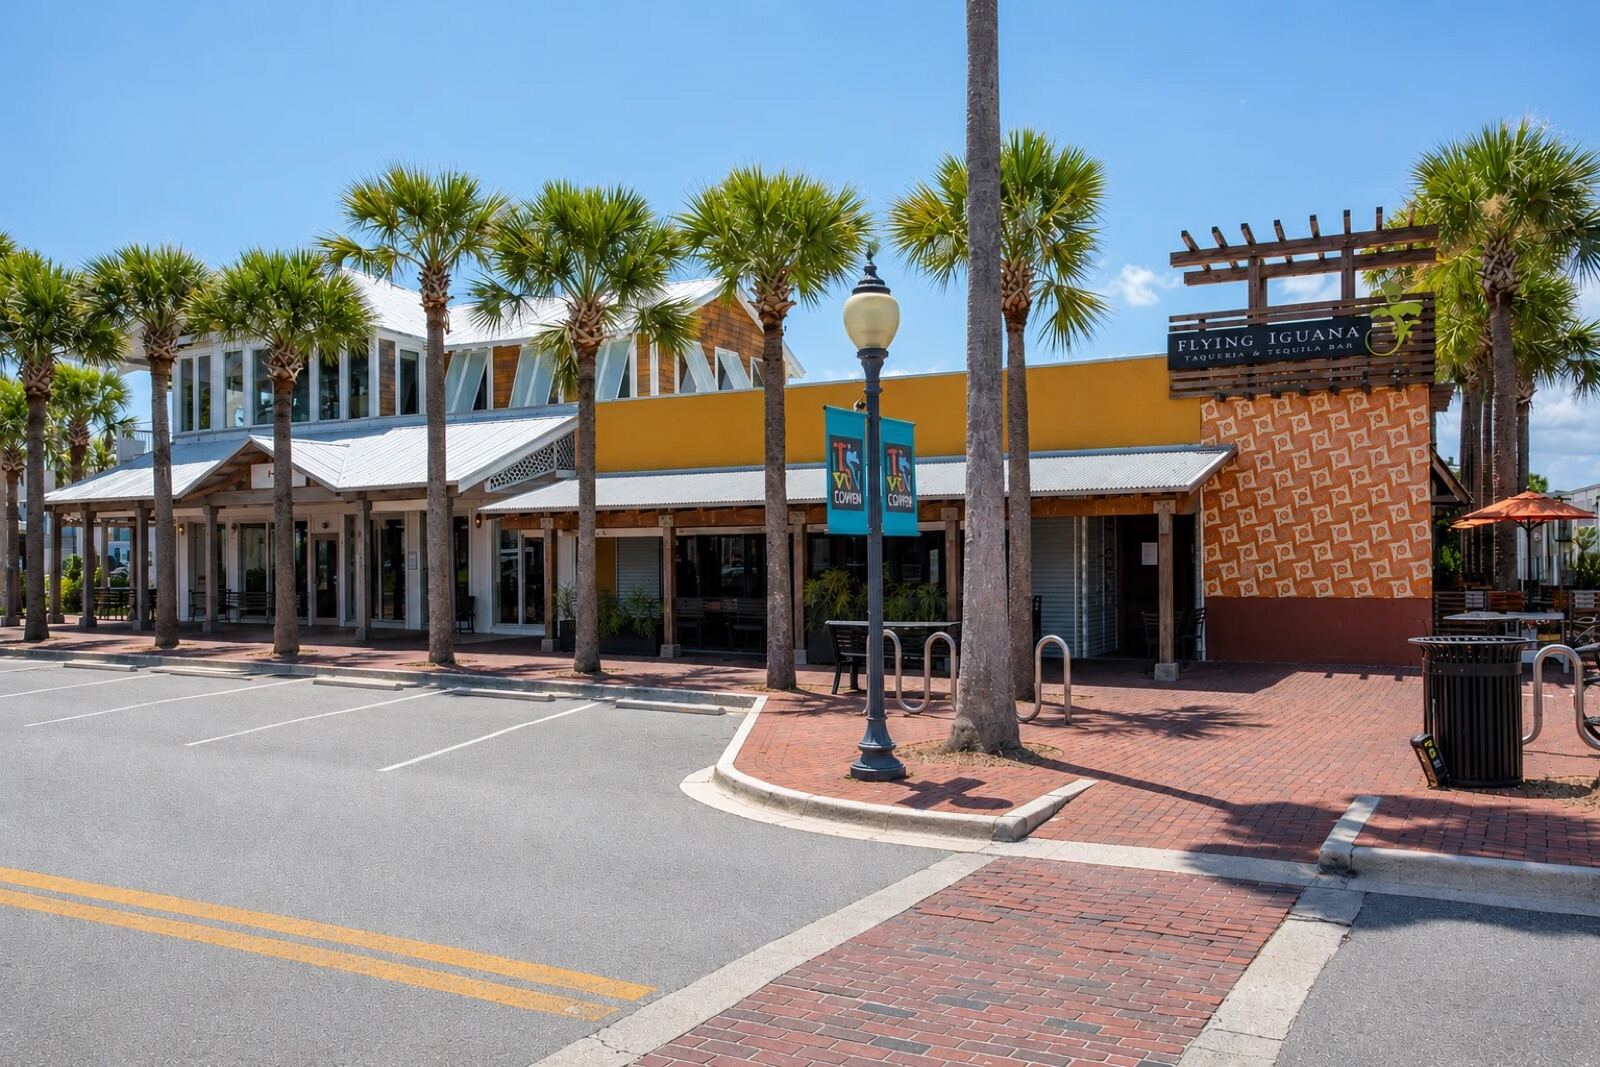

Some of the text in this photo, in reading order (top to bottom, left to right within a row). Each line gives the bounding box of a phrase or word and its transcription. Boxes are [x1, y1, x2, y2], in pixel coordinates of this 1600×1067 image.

[1177, 326, 1360, 352] FLYING IGUANA
[1183, 342, 1354, 363] TAQUERIA & TEQUILA BAR
